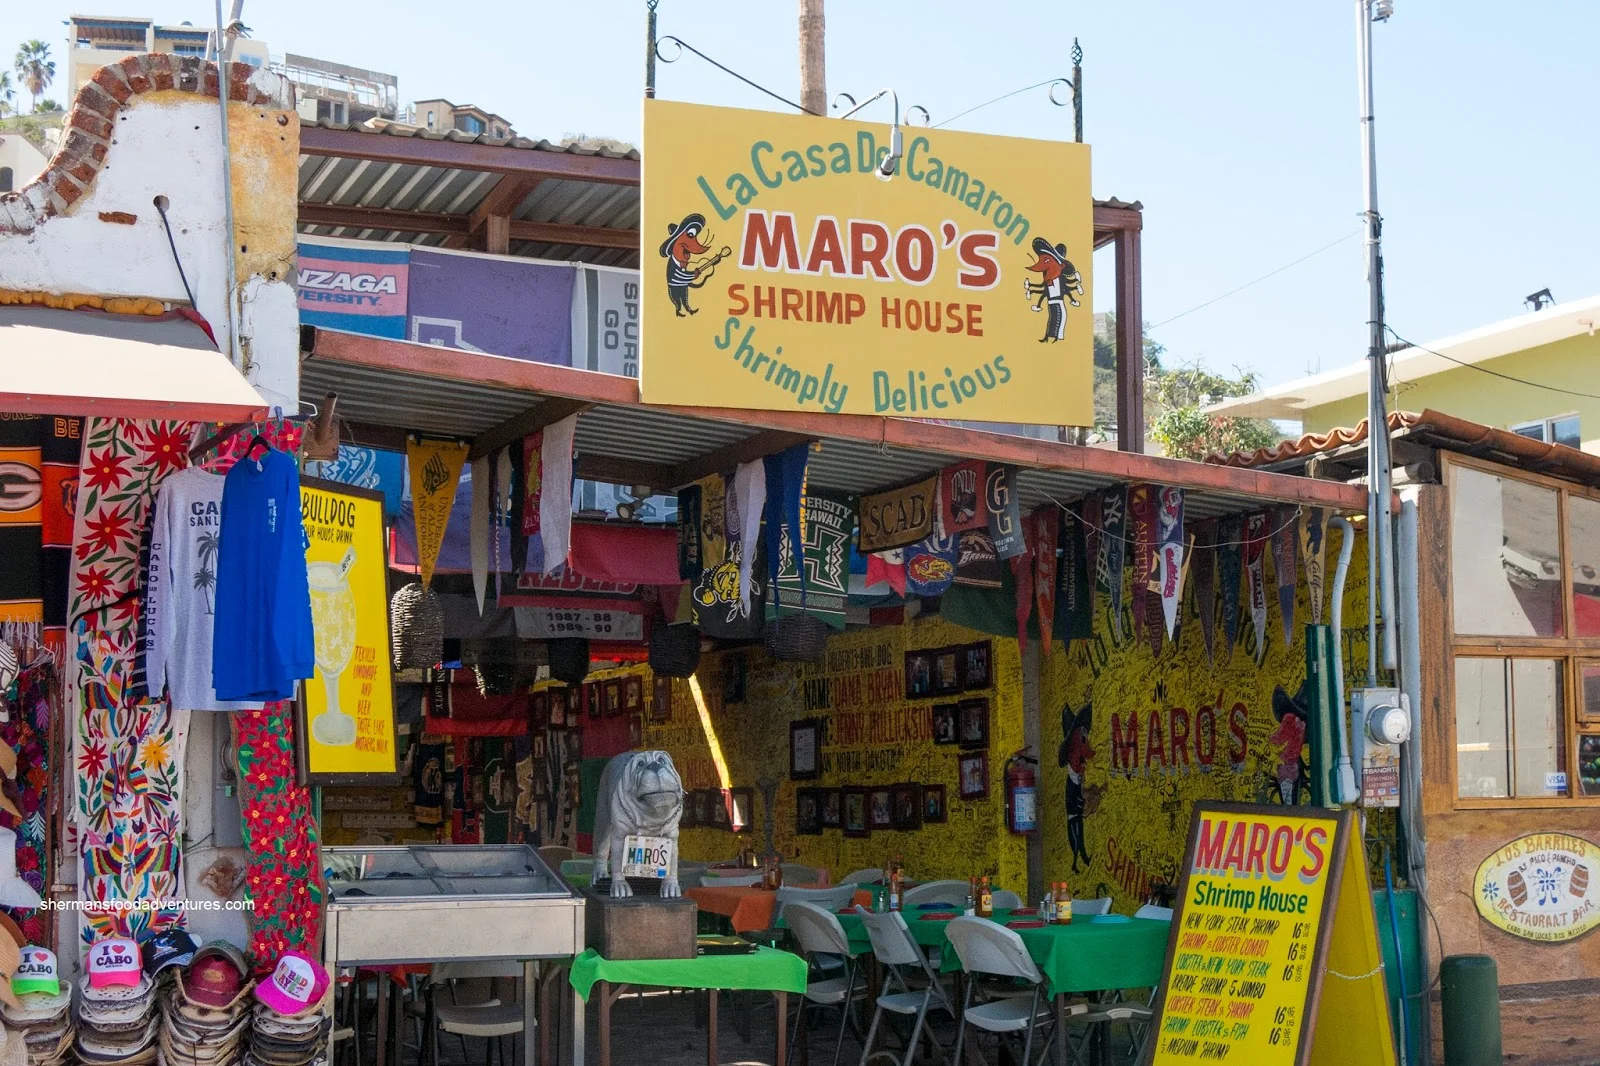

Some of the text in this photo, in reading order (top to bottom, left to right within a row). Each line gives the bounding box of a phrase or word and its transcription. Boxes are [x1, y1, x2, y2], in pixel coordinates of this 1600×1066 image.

[696, 173, 758, 221] La
[750, 140, 851, 189] Casa
[906, 136, 1030, 245] Camaron
[738, 209, 1001, 291] MARO'S
[728, 284, 983, 336] SHRIMP HOUSE
[604, 309, 619, 350] GO
[624, 282, 638, 377] SPURS
[715, 316, 1012, 413] Shrimply Delicious
[302, 492, 356, 528] BULLDOG
[869, 494, 928, 539] SCAD
[1110, 688, 1249, 779] MARO'S
[1190, 819, 1327, 885] MARO'S
[1496, 835, 1586, 867] LOS BARRILES
[1193, 880, 1308, 914] Shrimp House
[1497, 897, 1595, 929] RESTAURANT BAR
[1185, 912, 1204, 929] NEW
[1205, 913, 1226, 931] YORK
[1226, 916, 1250, 934] STEAK
[1249, 917, 1280, 936] SHRIMP
[23, 953, 31, 963] I
[96, 955, 133, 966] CABO
[102, 945, 110, 955] I
[1240, 938, 1269, 957] COMBO
[17, 963, 53, 974] CABO
[1199, 976, 1228, 996] SHRIMP
[1229, 980, 1238, 997] 5
[1237, 981, 1266, 999] JUMBO
[1166, 1037, 1199, 1056] MEDIUM
[1230, 1022, 1250, 1041] FISH
